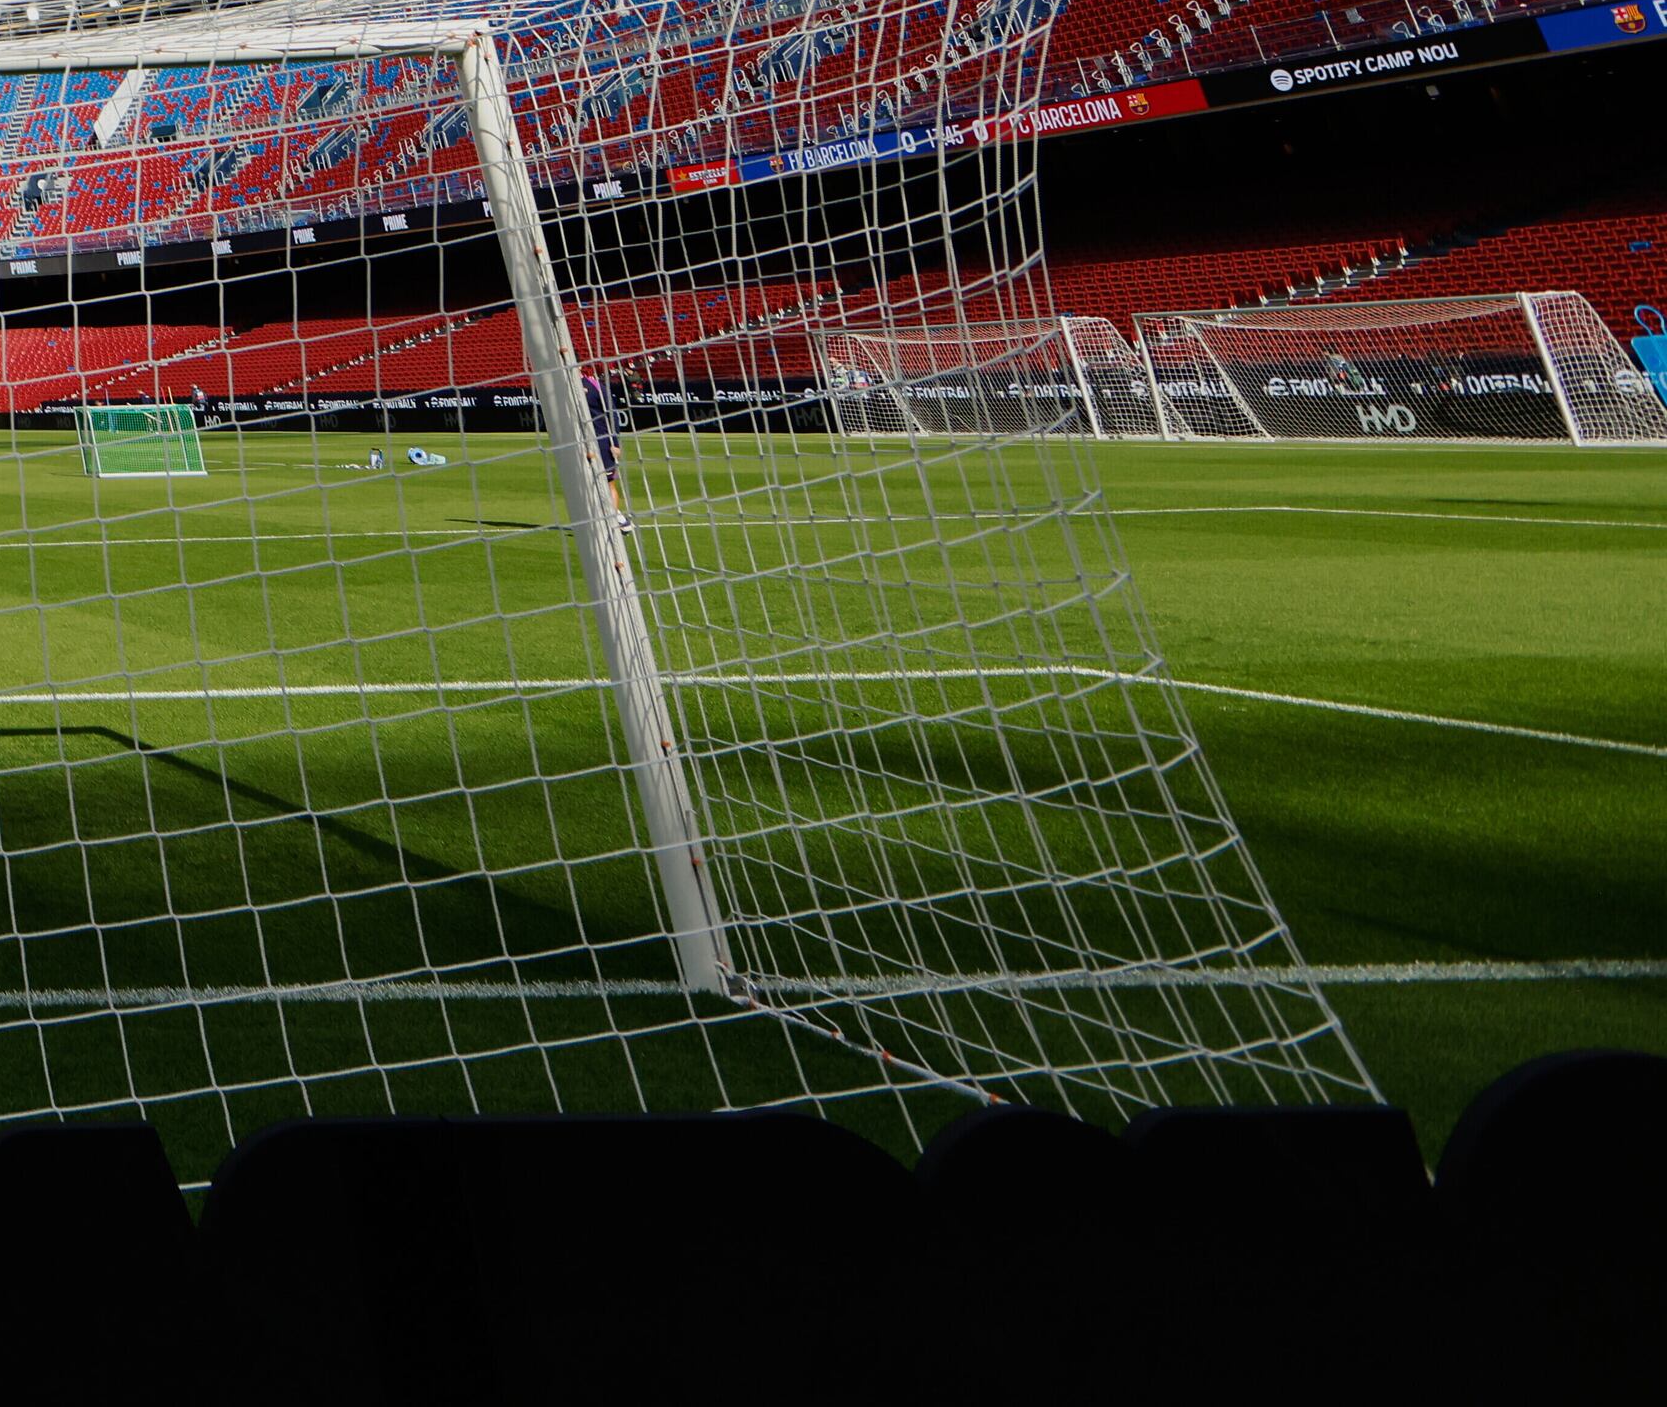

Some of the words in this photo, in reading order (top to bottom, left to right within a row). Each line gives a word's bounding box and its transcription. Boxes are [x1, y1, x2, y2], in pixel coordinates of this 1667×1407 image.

[1294, 59, 1363, 85] SPOTIFY
[1365, 50, 1415, 73] CAMP
[1416, 41, 1459, 64] NOU
[805, 139, 879, 169] BARCELONA
[900, 131, 917, 153] 0
[972, 119, 989, 143] 0
[1030, 97, 1122, 133] BARCELONA
[382, 213, 409, 232] PRIME
[292, 227, 316, 244] PRIME
[9, 260, 39, 275] PRIME
[204, 415, 221, 427] HMD
[1355, 404, 1417, 433] HMD
